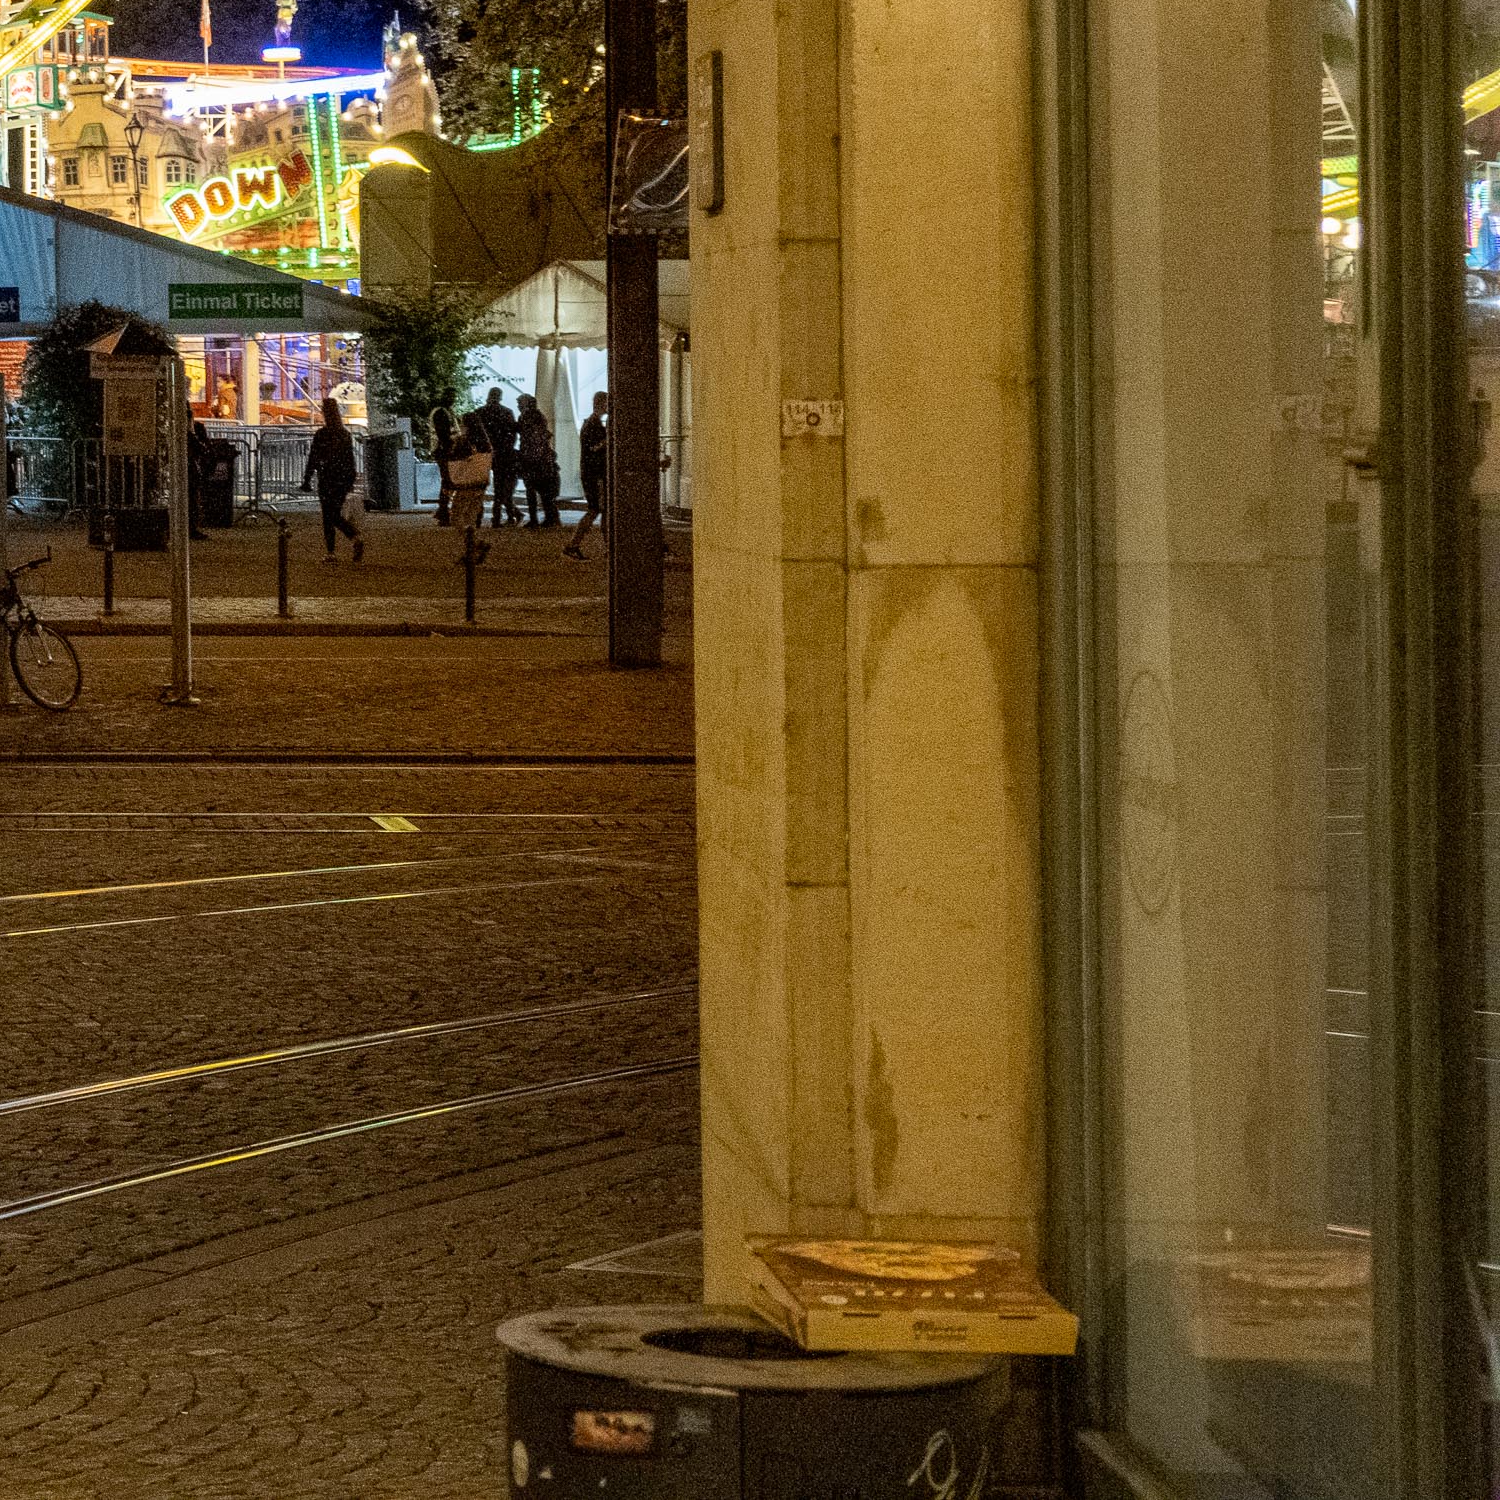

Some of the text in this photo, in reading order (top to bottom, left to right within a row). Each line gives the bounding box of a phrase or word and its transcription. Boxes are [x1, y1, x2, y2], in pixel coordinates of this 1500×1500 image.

[164, 149, 314, 242] DOWN
[171, 291, 302, 312] Einmal Ticket
